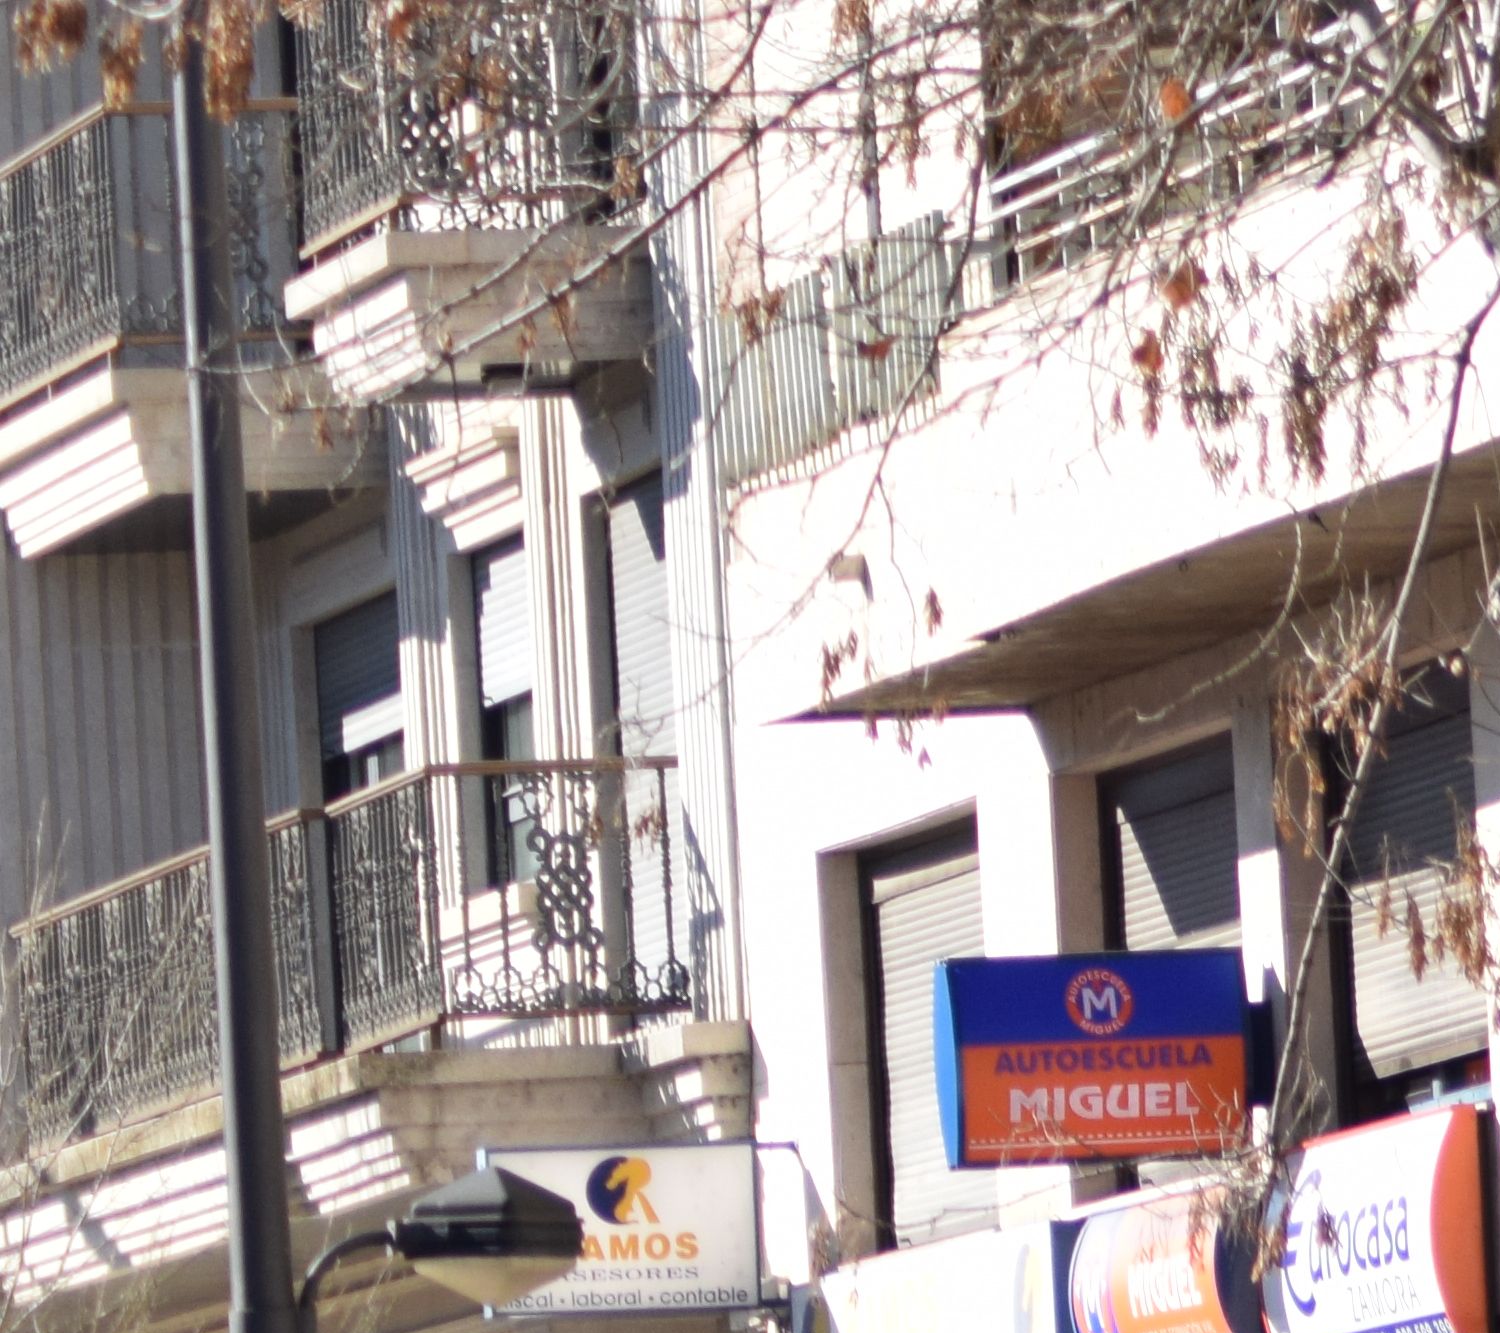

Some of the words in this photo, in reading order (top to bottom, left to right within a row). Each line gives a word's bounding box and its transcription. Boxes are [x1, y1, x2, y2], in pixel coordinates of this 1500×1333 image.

[1081, 987, 1118, 1020] M
[994, 1043, 1213, 1075] AUTOESCUELA
[1009, 1081, 1200, 1123] MIGUEL
[571, 1289, 642, 1307] laboral
[660, 1286, 748, 1304] contable
[1127, 1252, 1203, 1319] MIGUEL
[1348, 1274, 1422, 1322] ZAMORA
